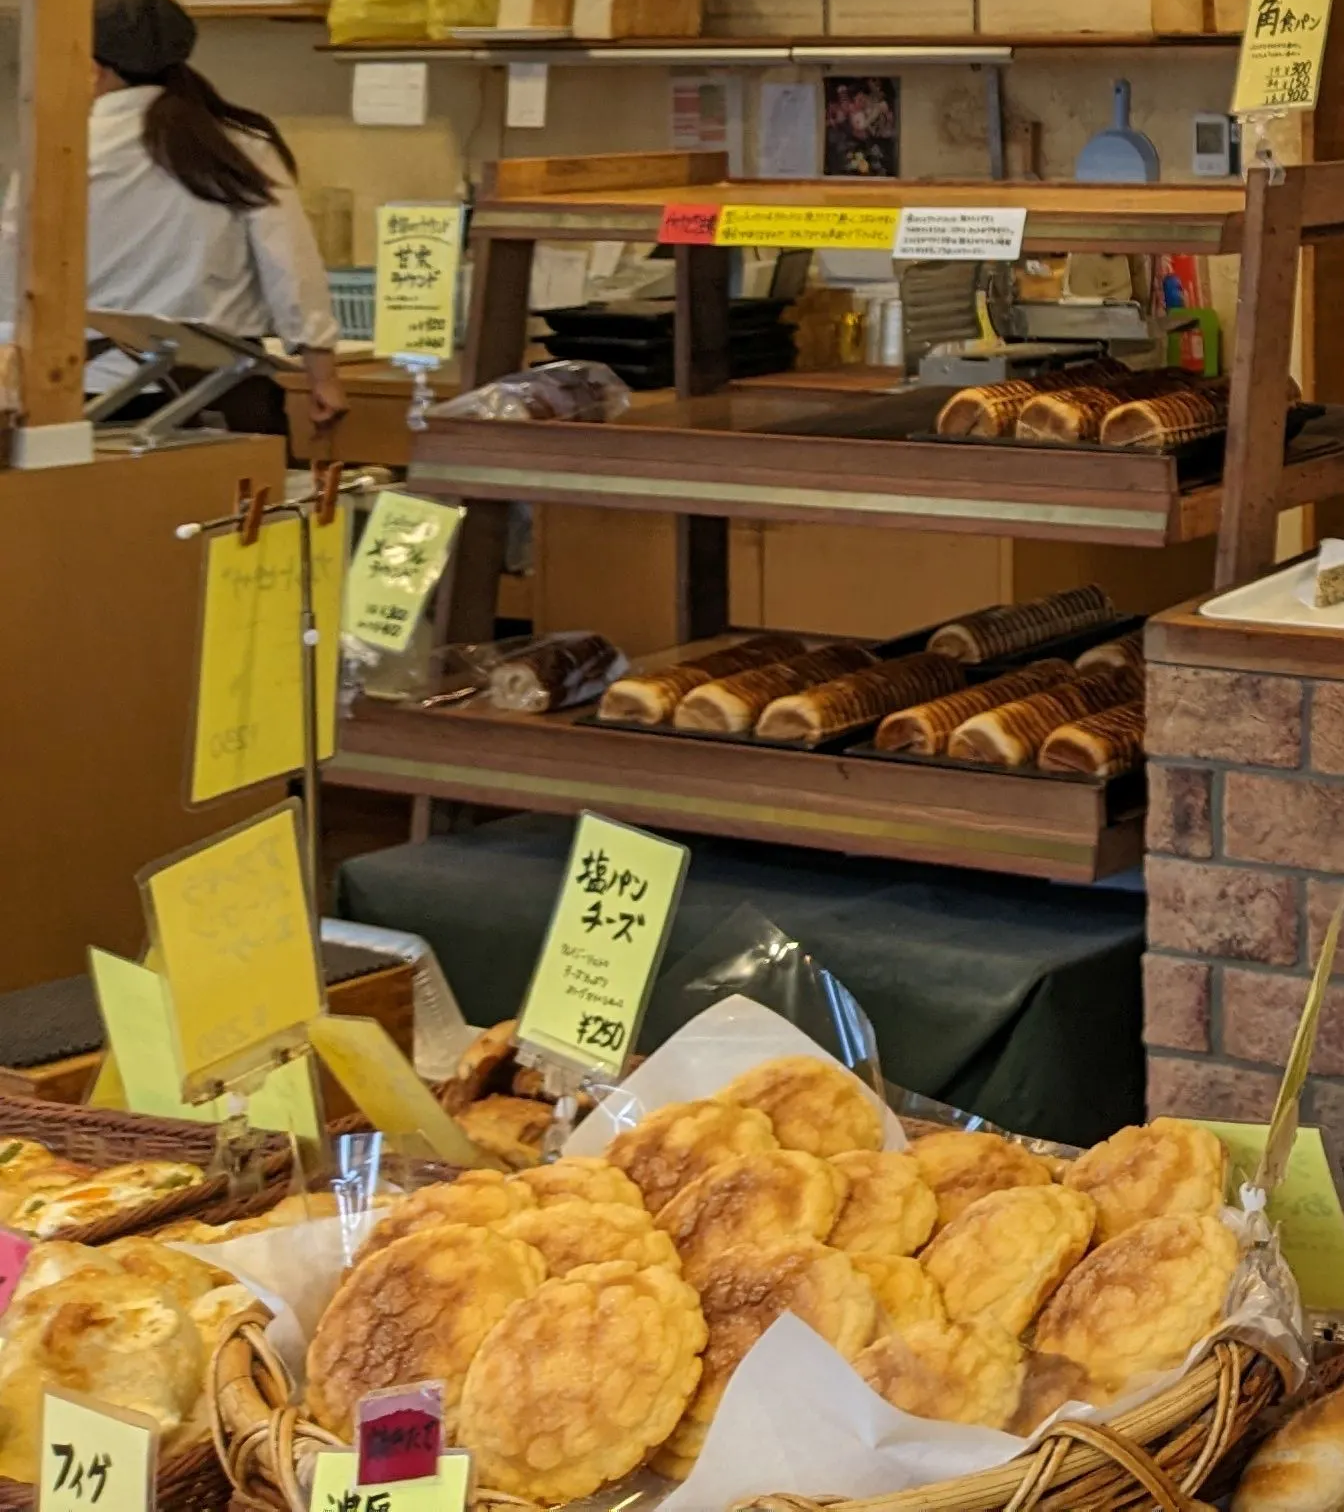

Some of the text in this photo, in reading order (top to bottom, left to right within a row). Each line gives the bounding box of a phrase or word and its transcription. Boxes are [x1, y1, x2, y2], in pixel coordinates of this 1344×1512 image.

[575, 849, 649, 902] 塩パン
[581, 900, 646, 944] チーズ
[576, 1011, 627, 1052] ¥250
[51, 1442, 113, 1503] フィグ
